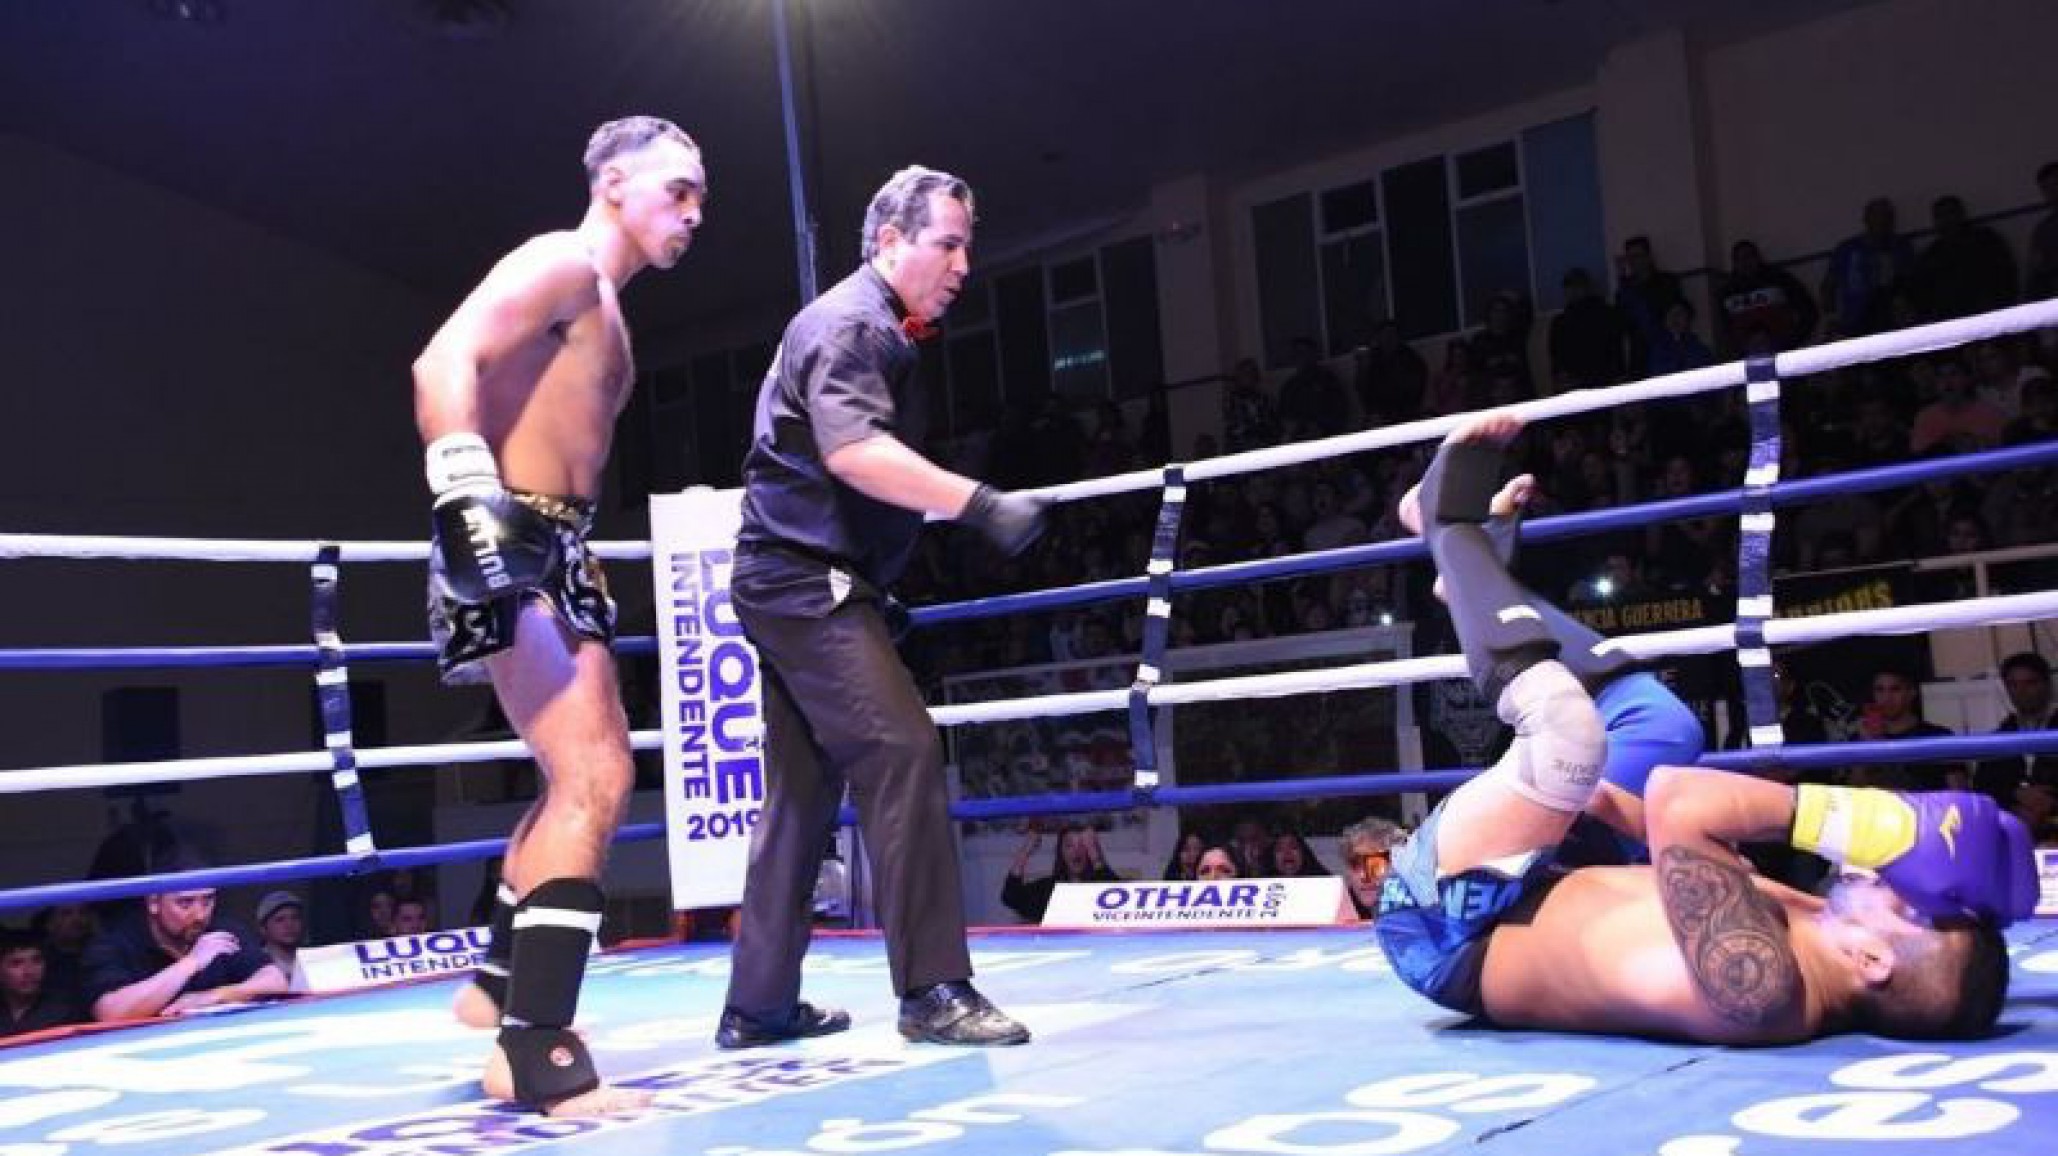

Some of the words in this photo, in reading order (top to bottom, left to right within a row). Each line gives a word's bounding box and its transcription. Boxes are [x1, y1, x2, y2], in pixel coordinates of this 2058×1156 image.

[671, 553, 711, 801] INTENDENTE
[700, 550, 763, 803] LUQUE
[1096, 884, 1261, 910] OTHAR
[354, 928, 493, 963] LUQU
[362, 953, 487, 979] INTENDE
